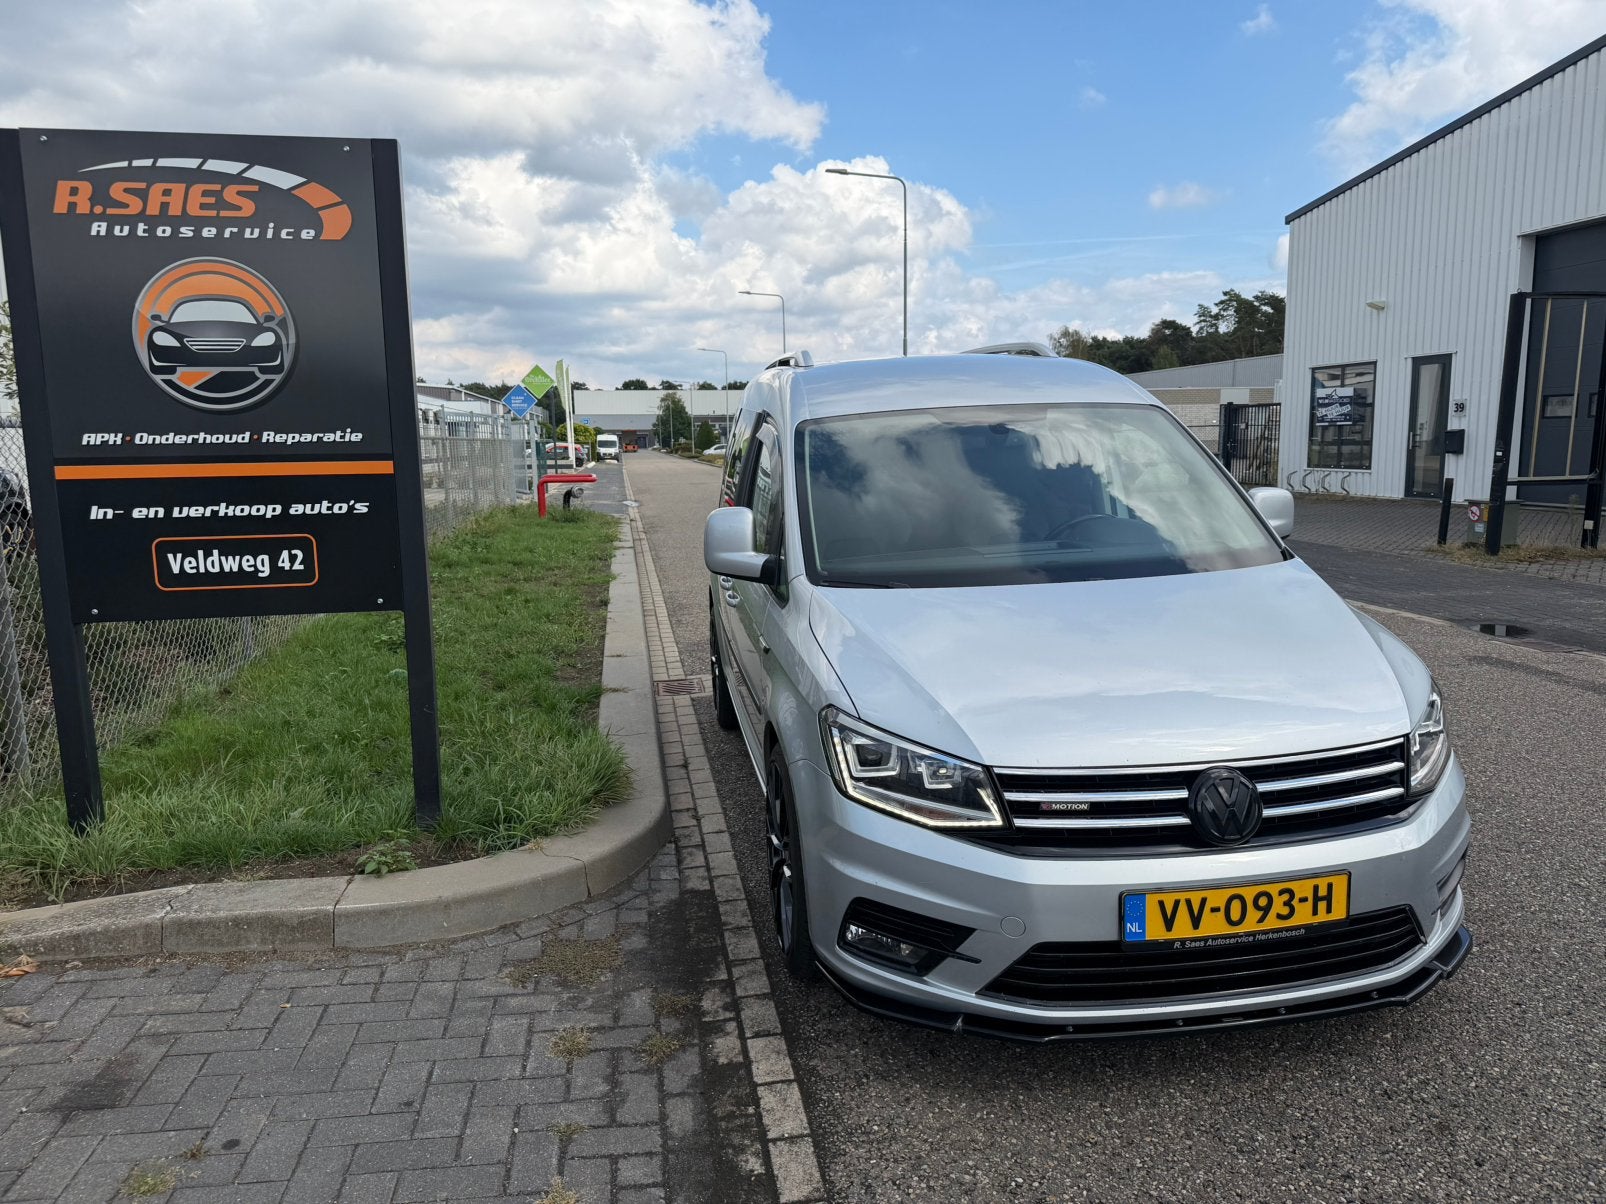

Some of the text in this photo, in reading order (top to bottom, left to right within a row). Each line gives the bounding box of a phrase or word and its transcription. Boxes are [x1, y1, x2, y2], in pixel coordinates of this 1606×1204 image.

[52, 180, 260, 218] R.SAES
[90, 221, 316, 240] Autoservice
[1453, 402, 1465, 413] 39
[81, 428, 363, 445] APK Onderhoud Reparatie
[89, 500, 370, 520] In- en verkoop auto's
[167, 549, 305, 577] Veldweg 42
[1157, 881, 1334, 933] VV-093-H
[1127, 922, 1143, 933] NL
[1173, 928, 1305, 949] R. Saes Autoservice Herkenbosch
